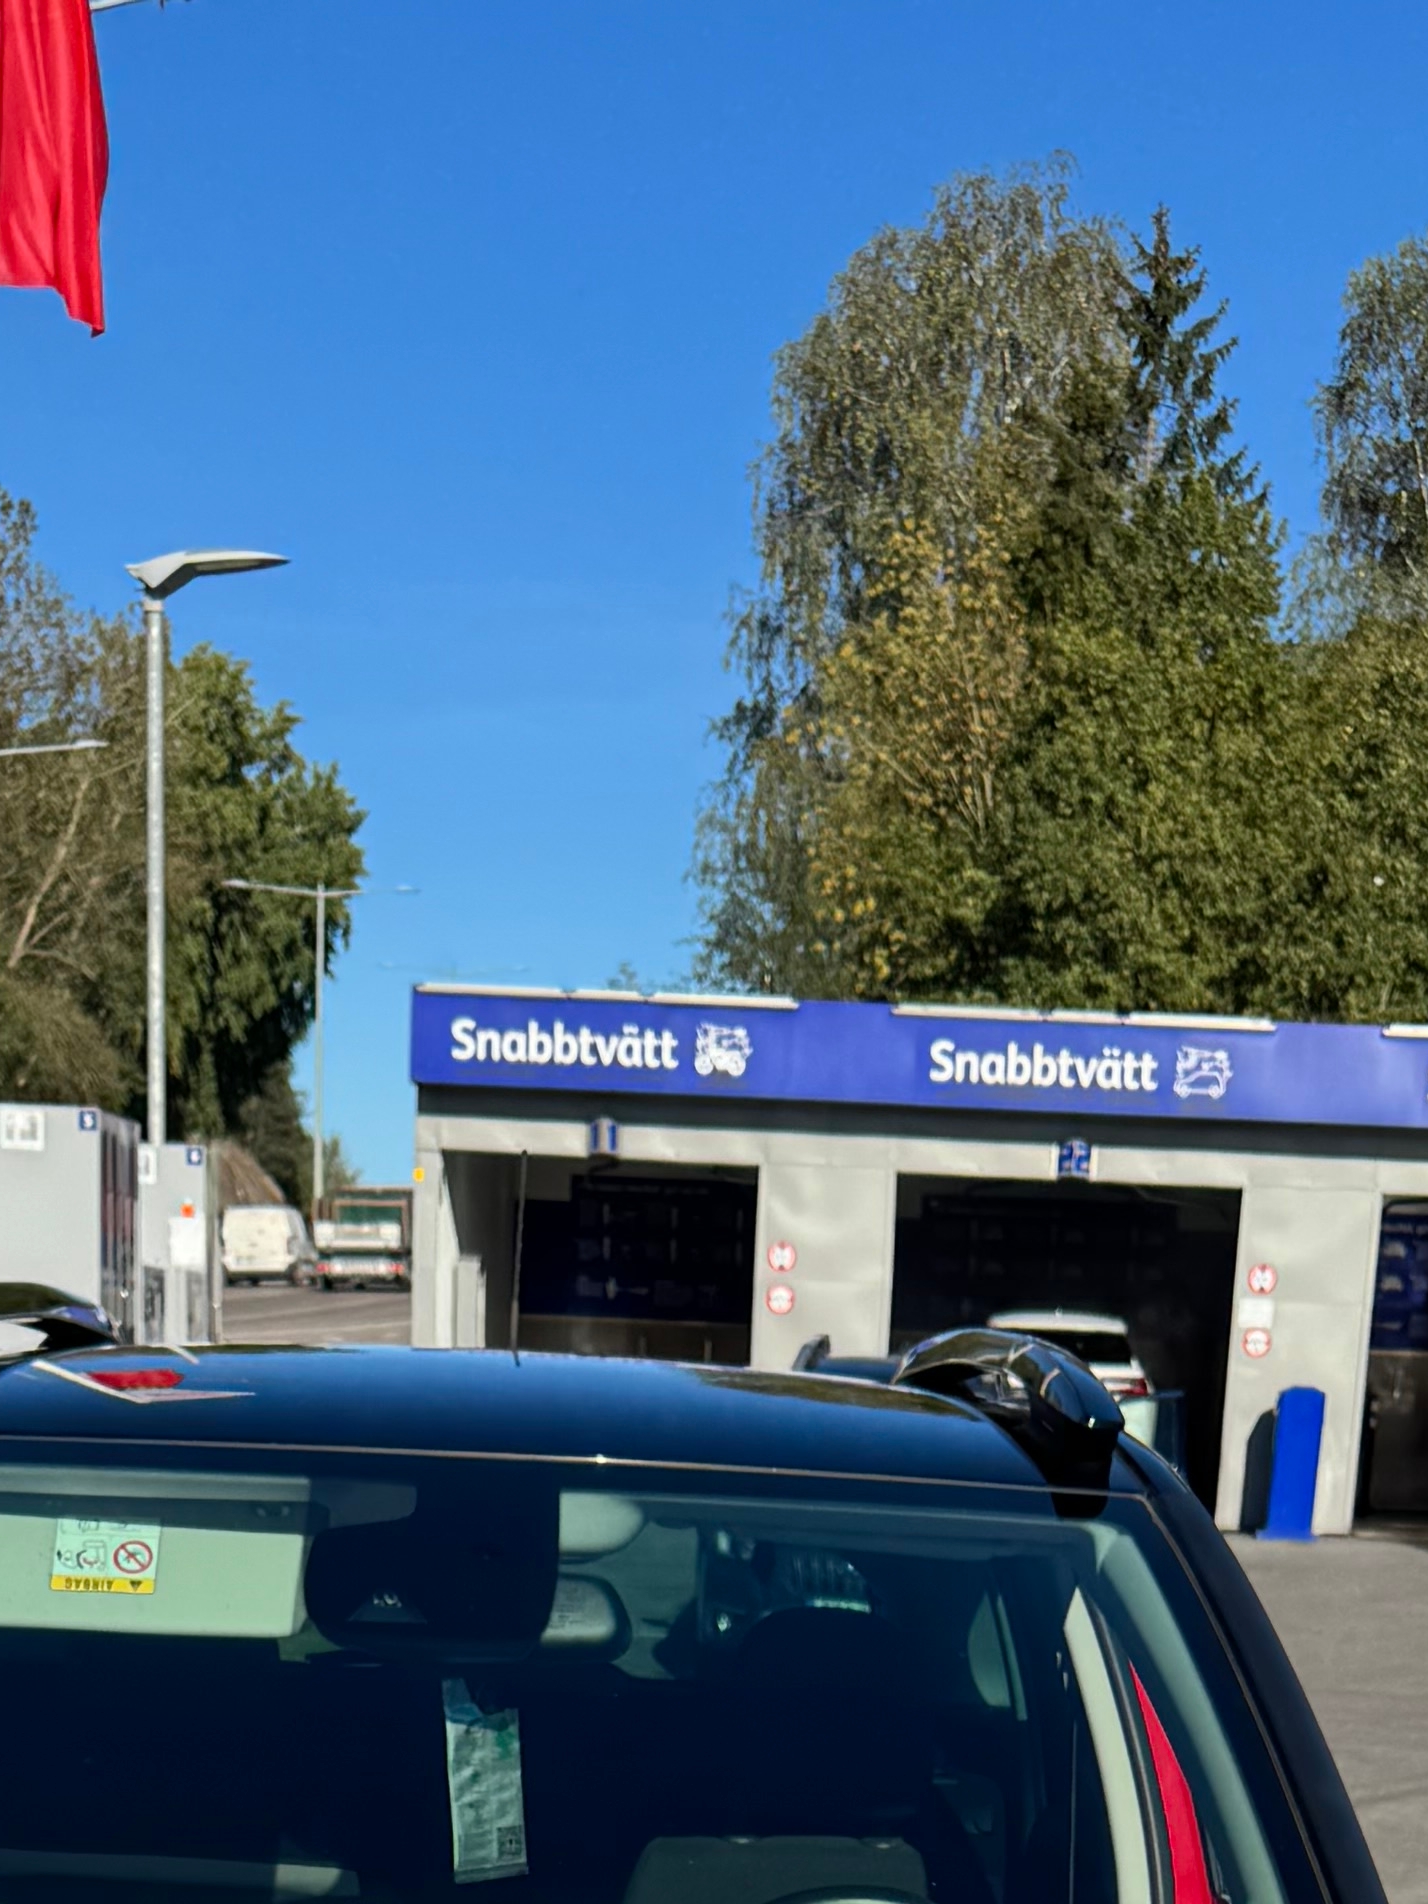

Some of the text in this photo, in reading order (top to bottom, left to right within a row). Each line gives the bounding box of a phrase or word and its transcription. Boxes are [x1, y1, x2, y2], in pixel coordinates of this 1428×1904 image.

[450, 1015, 680, 1070] Snabbtvätt
[928, 1037, 1159, 1092] Snabbtvätt
[64, 1577, 115, 1591] AIRBAG
